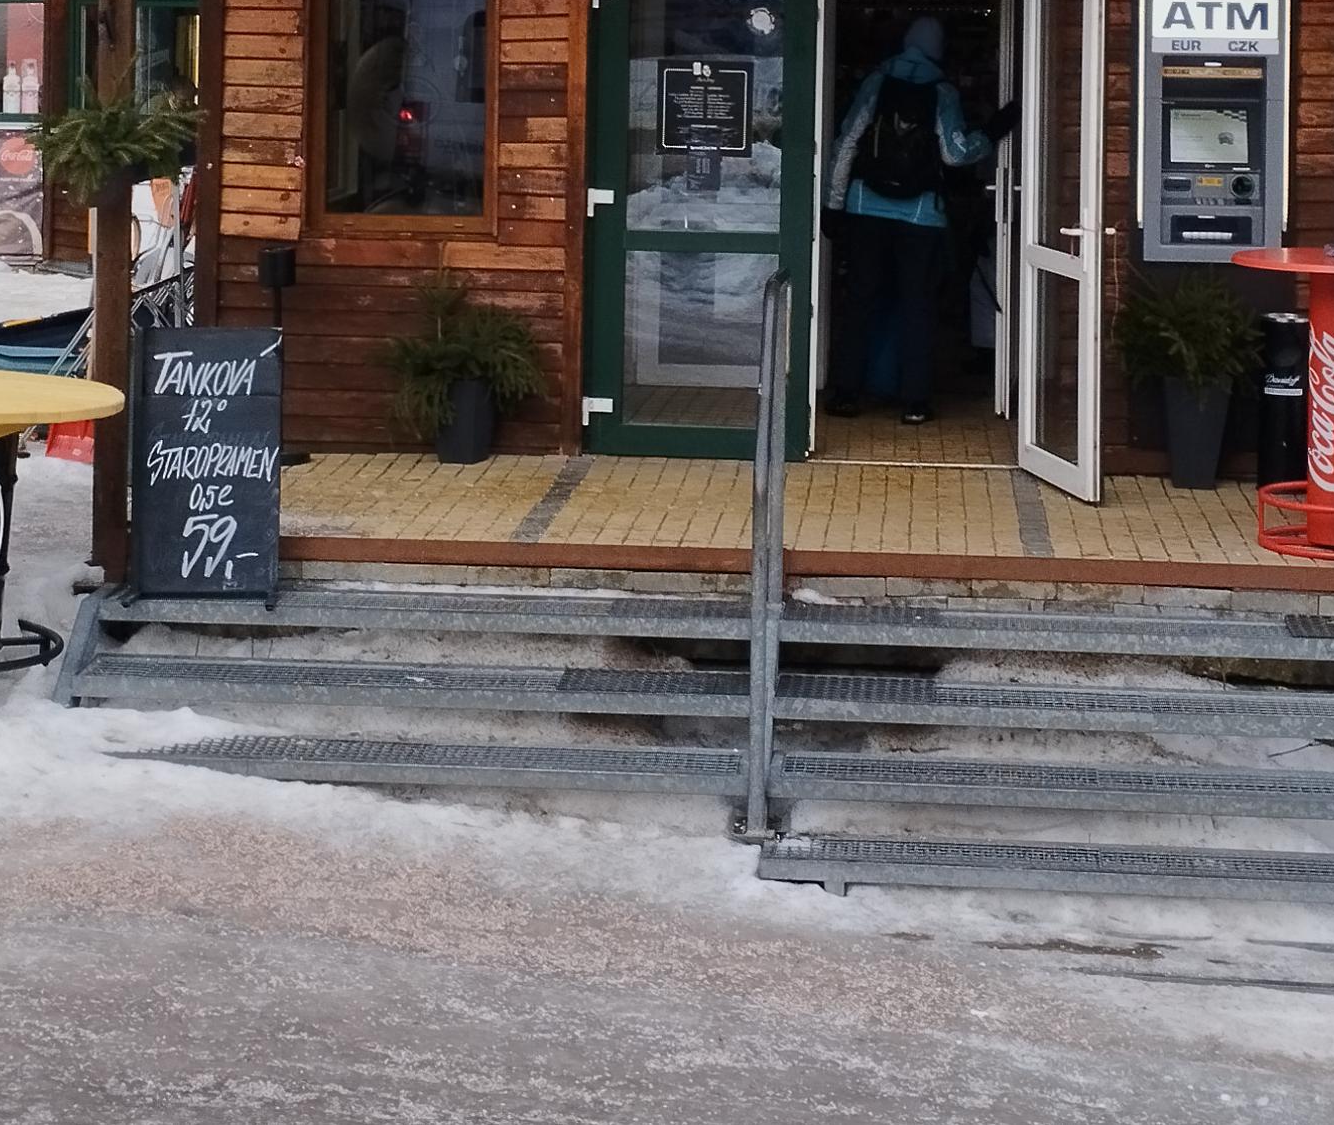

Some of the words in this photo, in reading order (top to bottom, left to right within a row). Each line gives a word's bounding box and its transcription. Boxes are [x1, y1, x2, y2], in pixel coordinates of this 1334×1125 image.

[1162, 1, 1269, 31] ATM
[1171, 40, 1202, 51] EUR
[1228, 41, 1259, 52] CZK
[153, 335, 283, 396] TANKOVÁ
[147, 439, 280, 487] STAROPRAMEN
